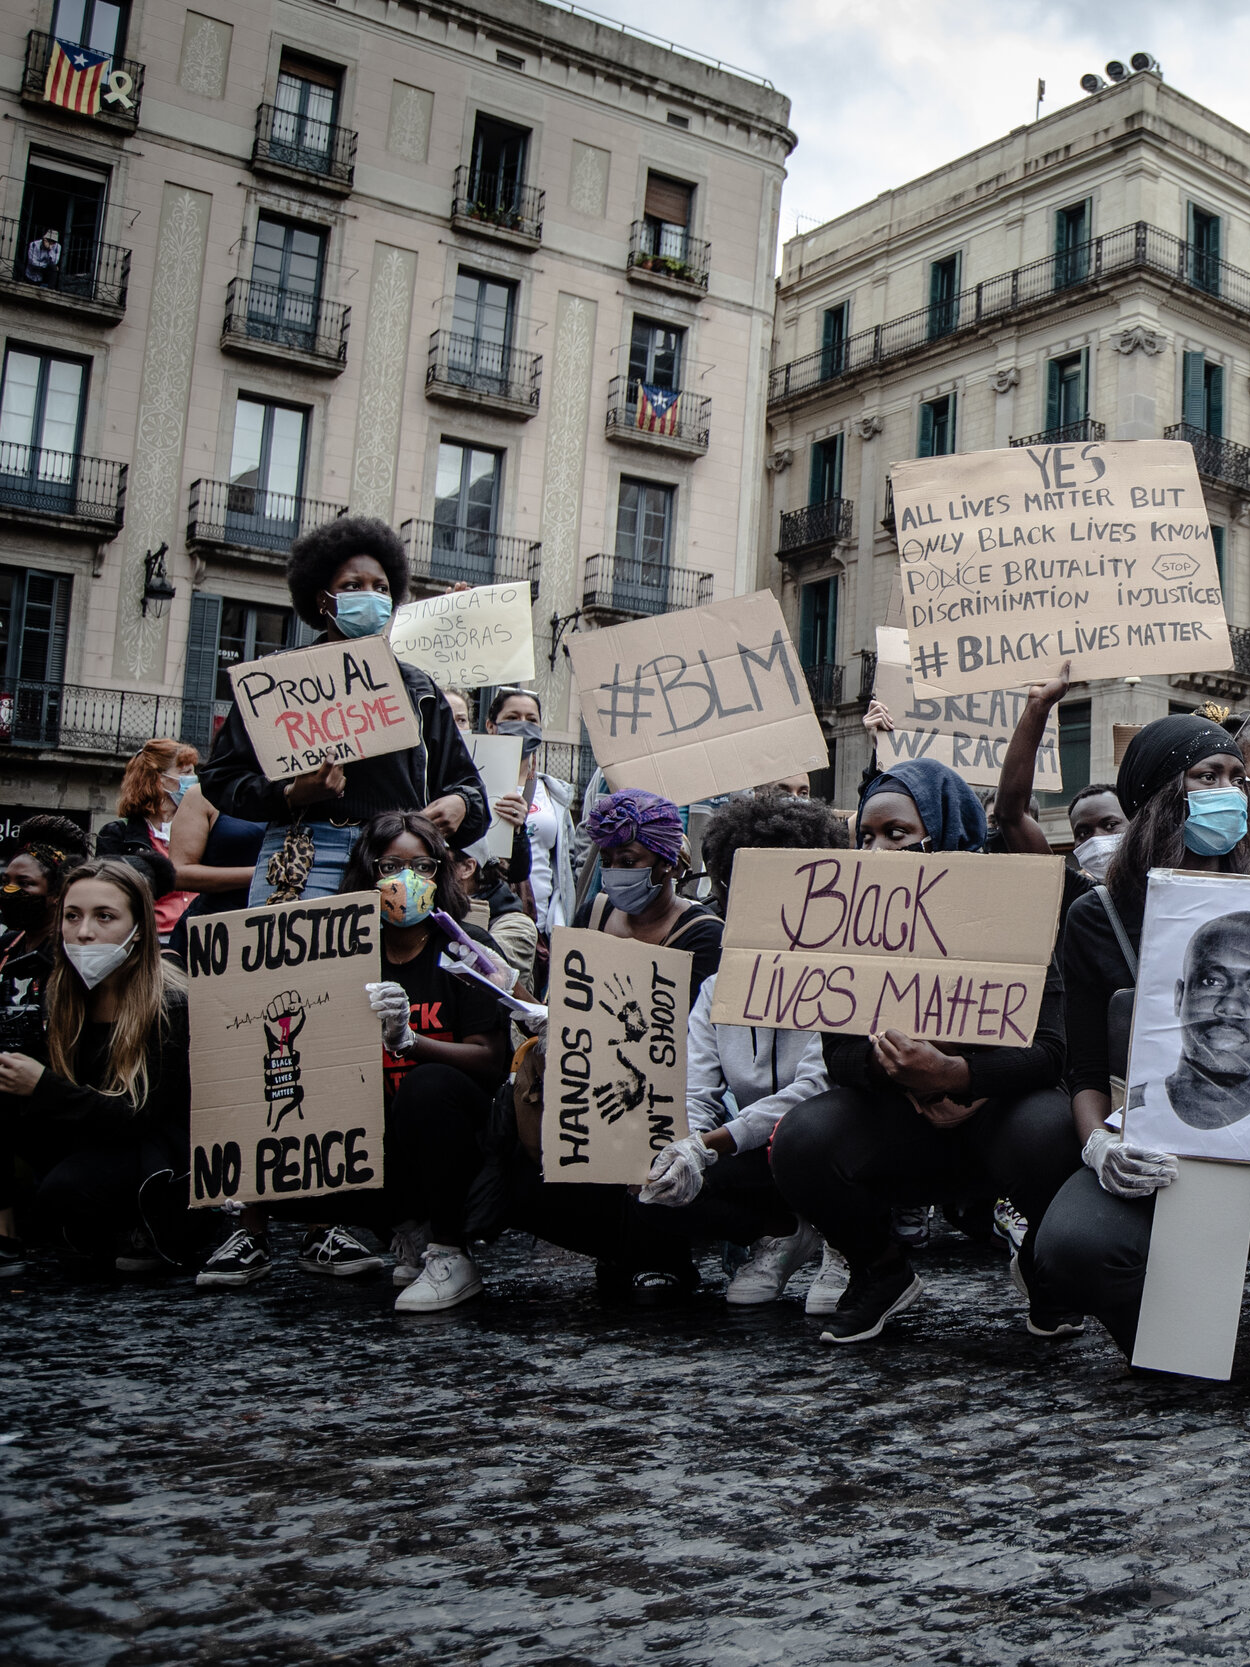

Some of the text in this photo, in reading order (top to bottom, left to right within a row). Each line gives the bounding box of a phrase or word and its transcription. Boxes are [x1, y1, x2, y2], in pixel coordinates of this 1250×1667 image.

[1026, 444, 1106, 489] YES
[901, 486, 1185, 531] ALL LIVES MATTER BUT
[902, 517, 1210, 563] ONLY BLACK LIVES KNOW
[1001, 554, 1137, 586] BRUTALITY
[1161, 561, 1191, 572] STOP
[394, 589, 517, 627] SINDICATO
[434, 615, 466, 632] DE
[218, 649, 239, 658] COSTA
[391, 624, 512, 655] CUIDADORAS
[1127, 621, 1212, 647] MATTER
[434, 651, 466, 663] SIN
[237, 652, 389, 718] PROU AL
[597, 630, 801, 737] #BLM
[905, 689, 1056, 734] BREAT
[276, 755, 303, 773] JA
[886, 727, 1058, 773] W/ RACM
[190, 904, 375, 978] NO JUSTICE
[271, 1057, 293, 1069] BLACK
[274, 1072, 293, 1083] LIVES
[559, 949, 595, 1167] HANDS UP
[647, 961, 677, 1155] ON'T SHOOT
[271, 1086, 295, 1099] MATTER
[194, 1127, 375, 1200] NO PEACE
